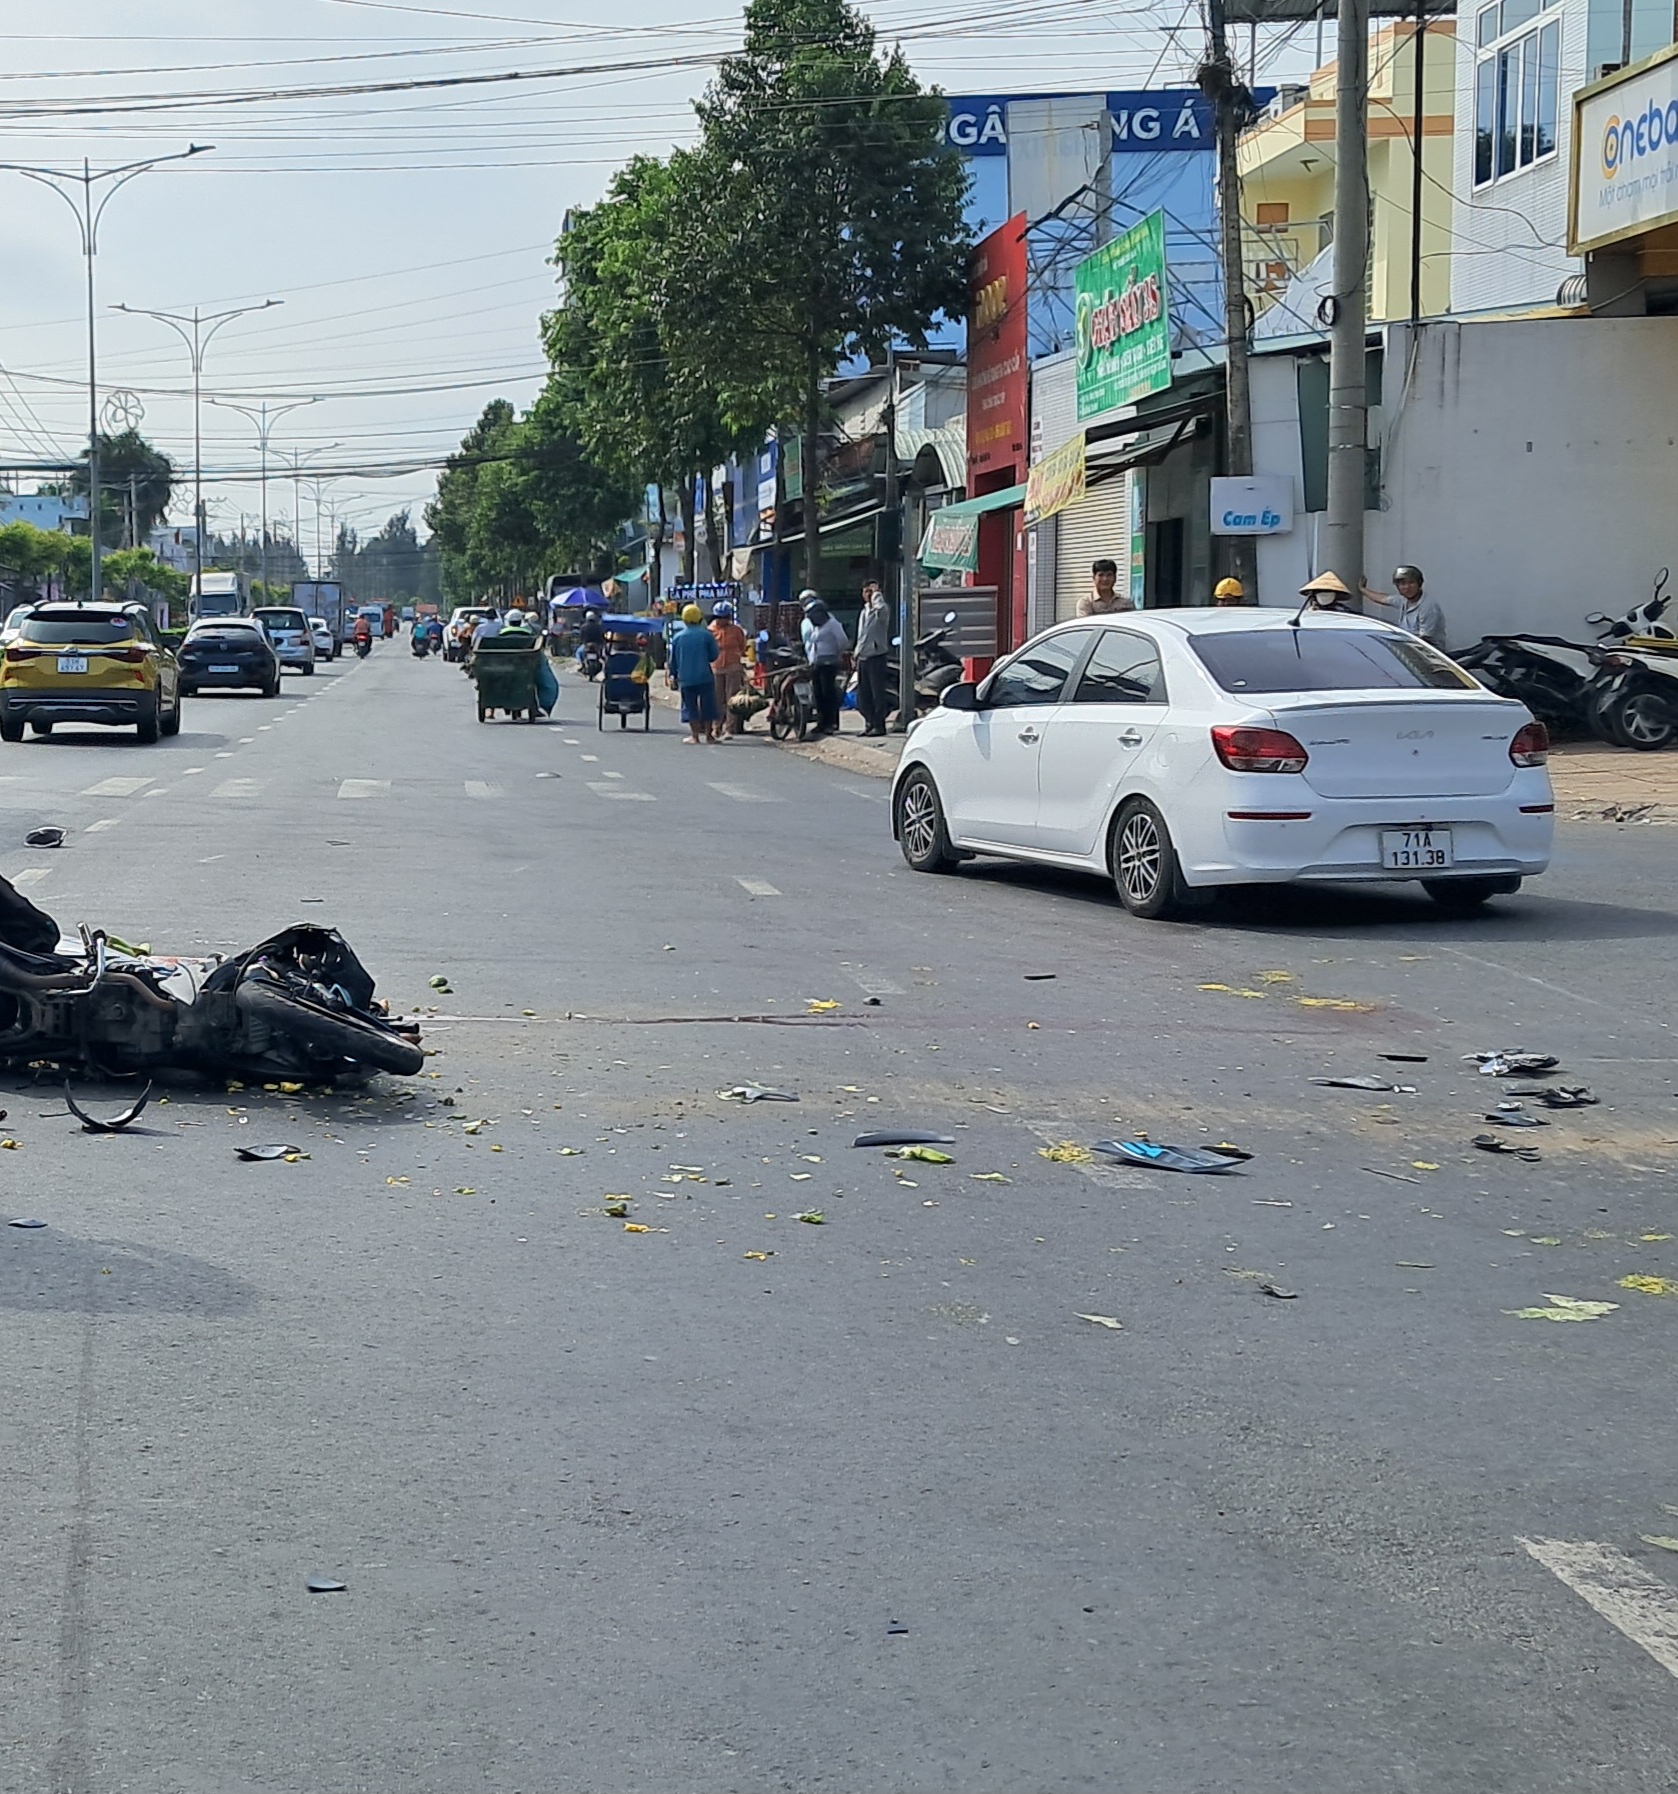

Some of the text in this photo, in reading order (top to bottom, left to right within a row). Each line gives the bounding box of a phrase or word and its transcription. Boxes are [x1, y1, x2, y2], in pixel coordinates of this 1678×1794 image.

[1173, 99, 1200, 139] Á
[1223, 505, 1281, 528] Cam Ép
[1402, 832, 1432, 848] 71A
[1392, 849, 1445, 866] 131.38
